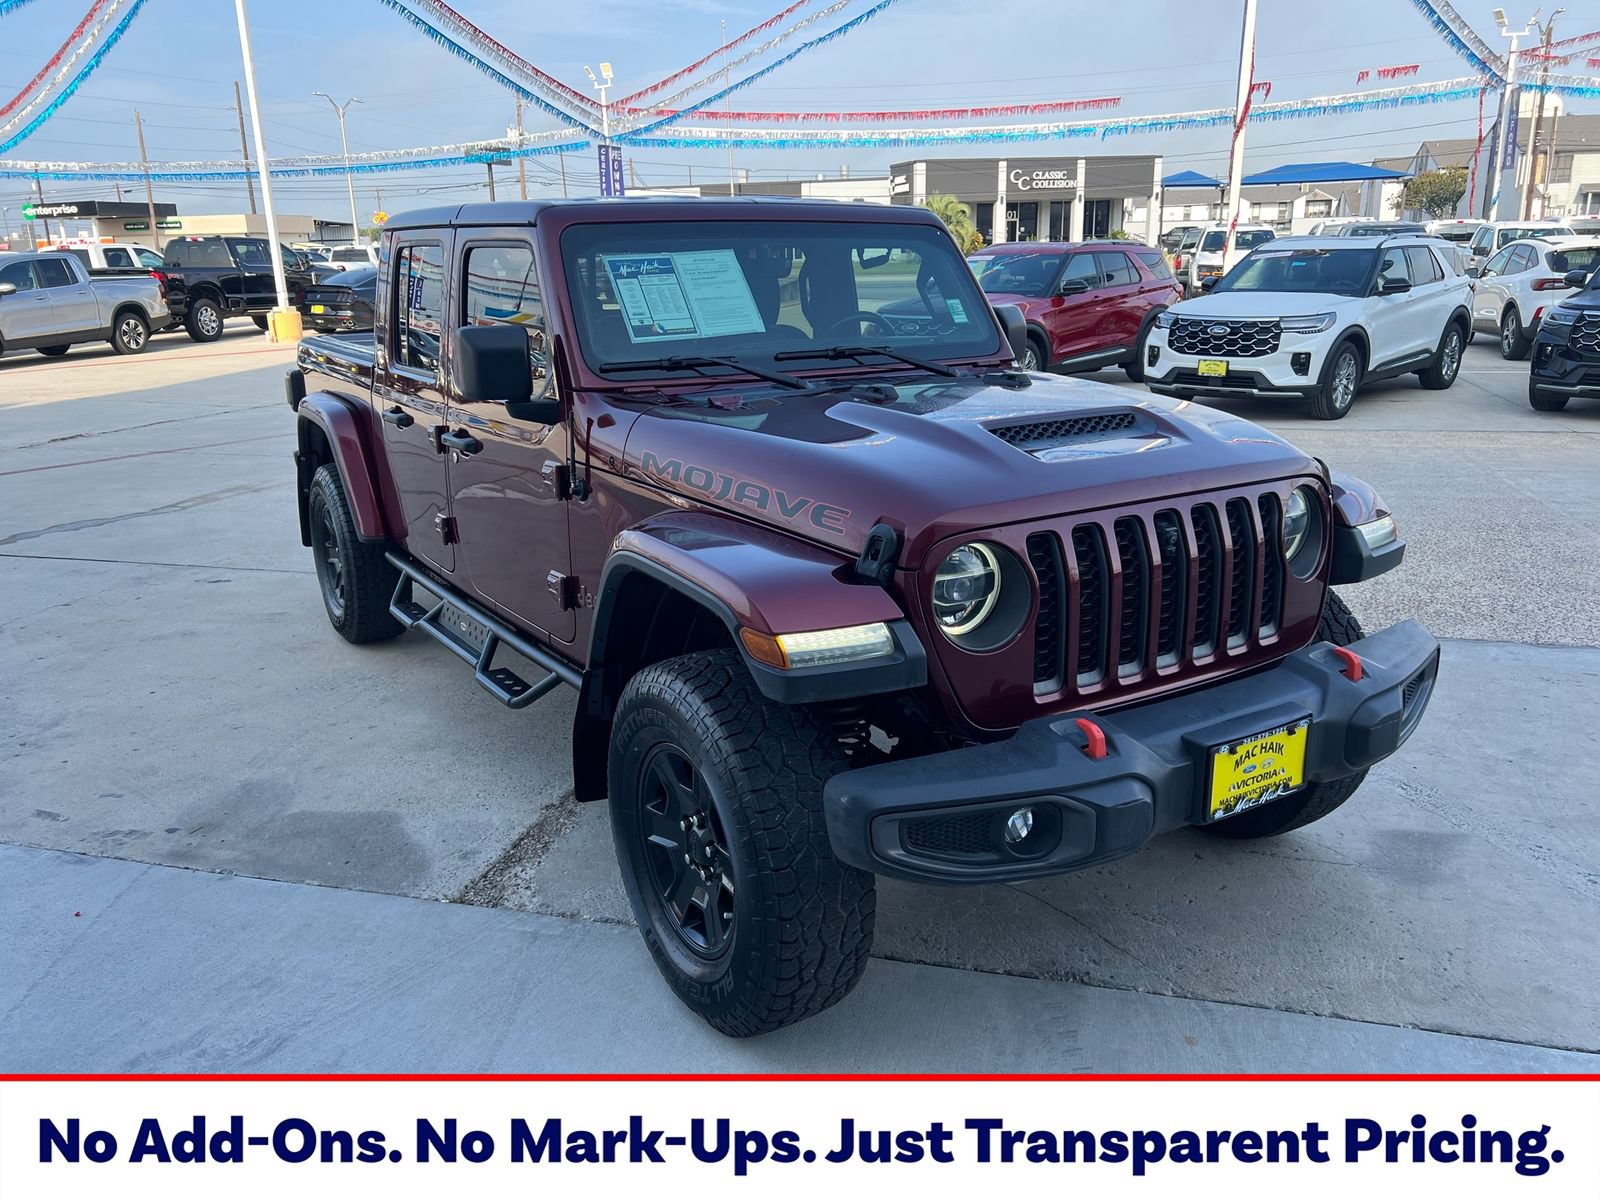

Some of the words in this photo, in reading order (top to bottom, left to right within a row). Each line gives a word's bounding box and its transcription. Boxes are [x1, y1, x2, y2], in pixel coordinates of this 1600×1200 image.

[1032, 171, 1068, 180] CLASSIC
[1032, 180, 1077, 189] COLLISION
[22, 204, 78, 216] enterprise
[640, 450, 852, 536] MOJAVE
[1234, 745, 1258, 772] MAC
[1259, 741, 1285, 756] HAIK
[1236, 769, 1278, 790] VICTORIA
[1259, 785, 1297, 804] Haik
